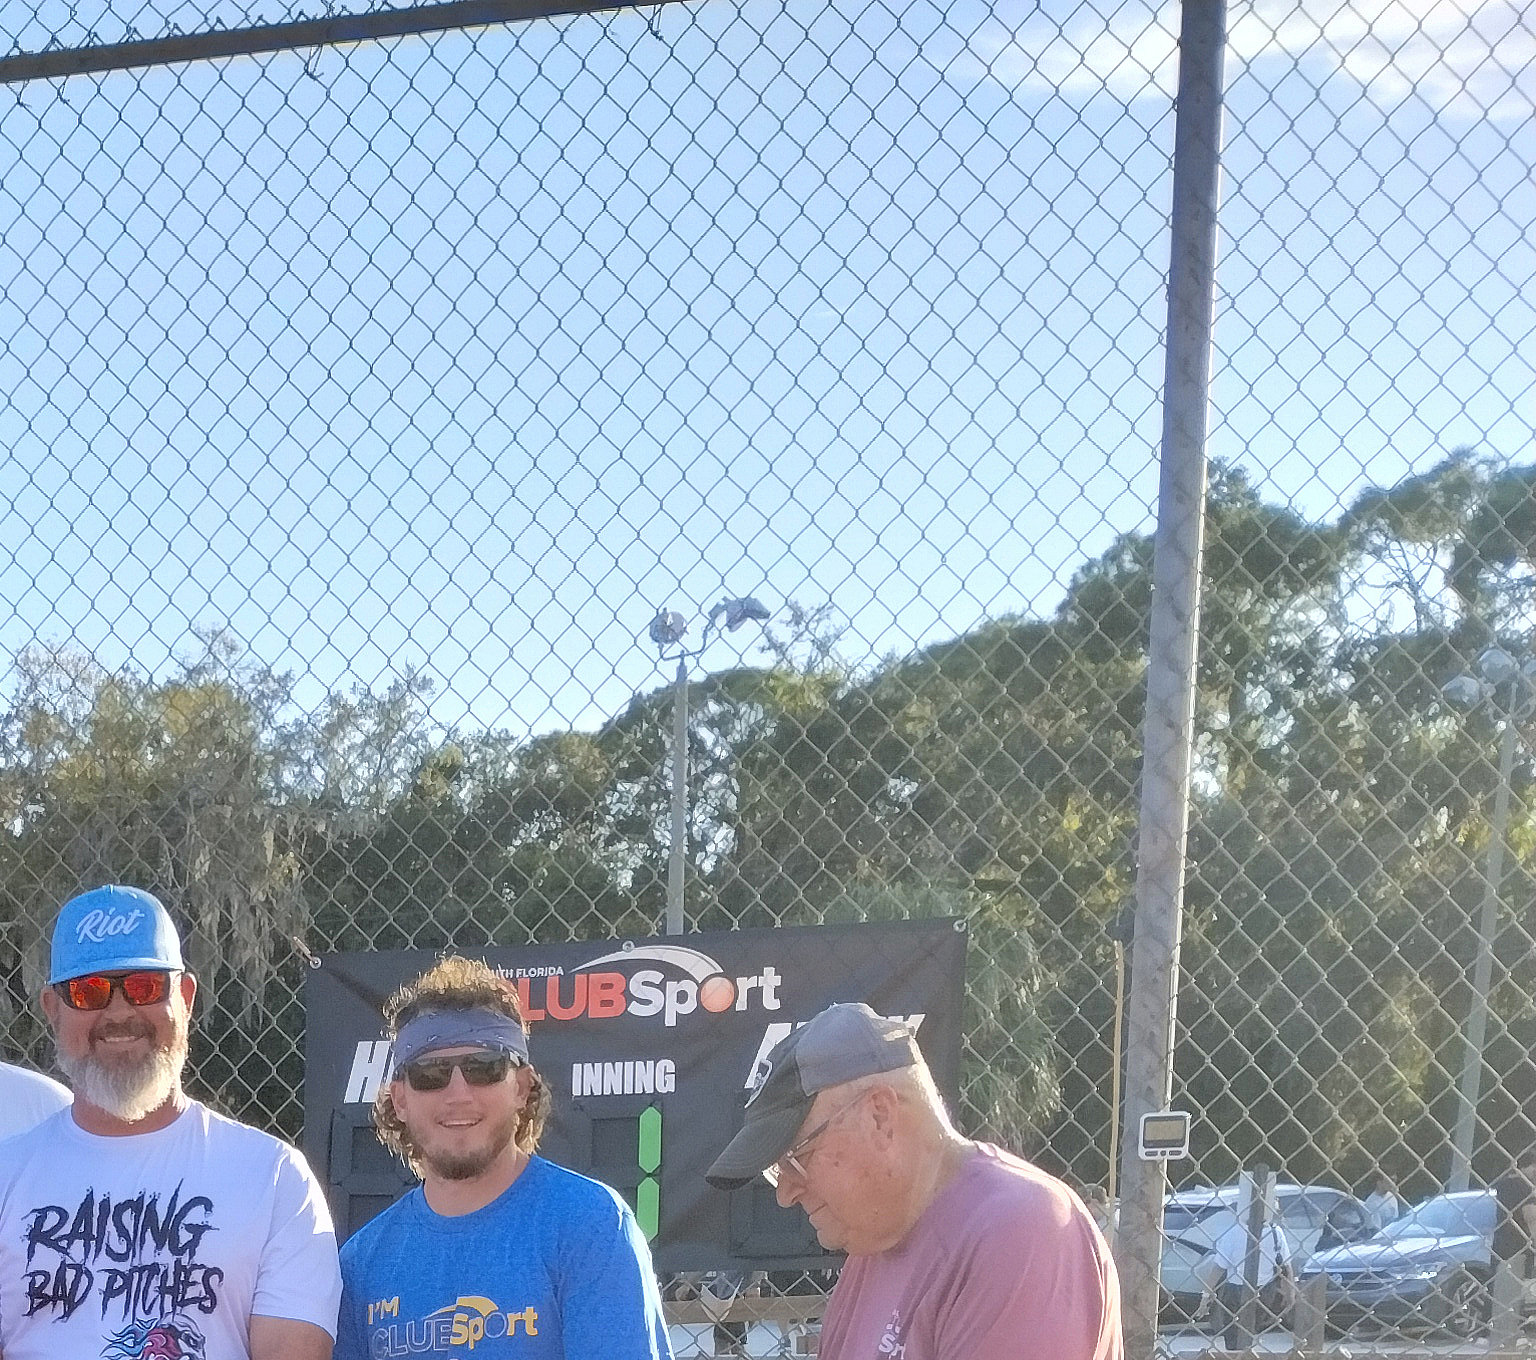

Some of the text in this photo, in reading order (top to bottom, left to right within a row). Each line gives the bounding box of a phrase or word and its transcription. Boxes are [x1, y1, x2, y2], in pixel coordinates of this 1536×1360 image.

[76, 907, 145, 944] Riot
[516, 966, 564, 979] FLORIDA
[517, 966, 782, 1027] LUBSport
[572, 1059, 676, 1097] INNING
[636, 1106, 662, 1244] 1
[20, 1178, 220, 1272] RAISING
[21, 1257, 224, 1323] BAD PITCHES
